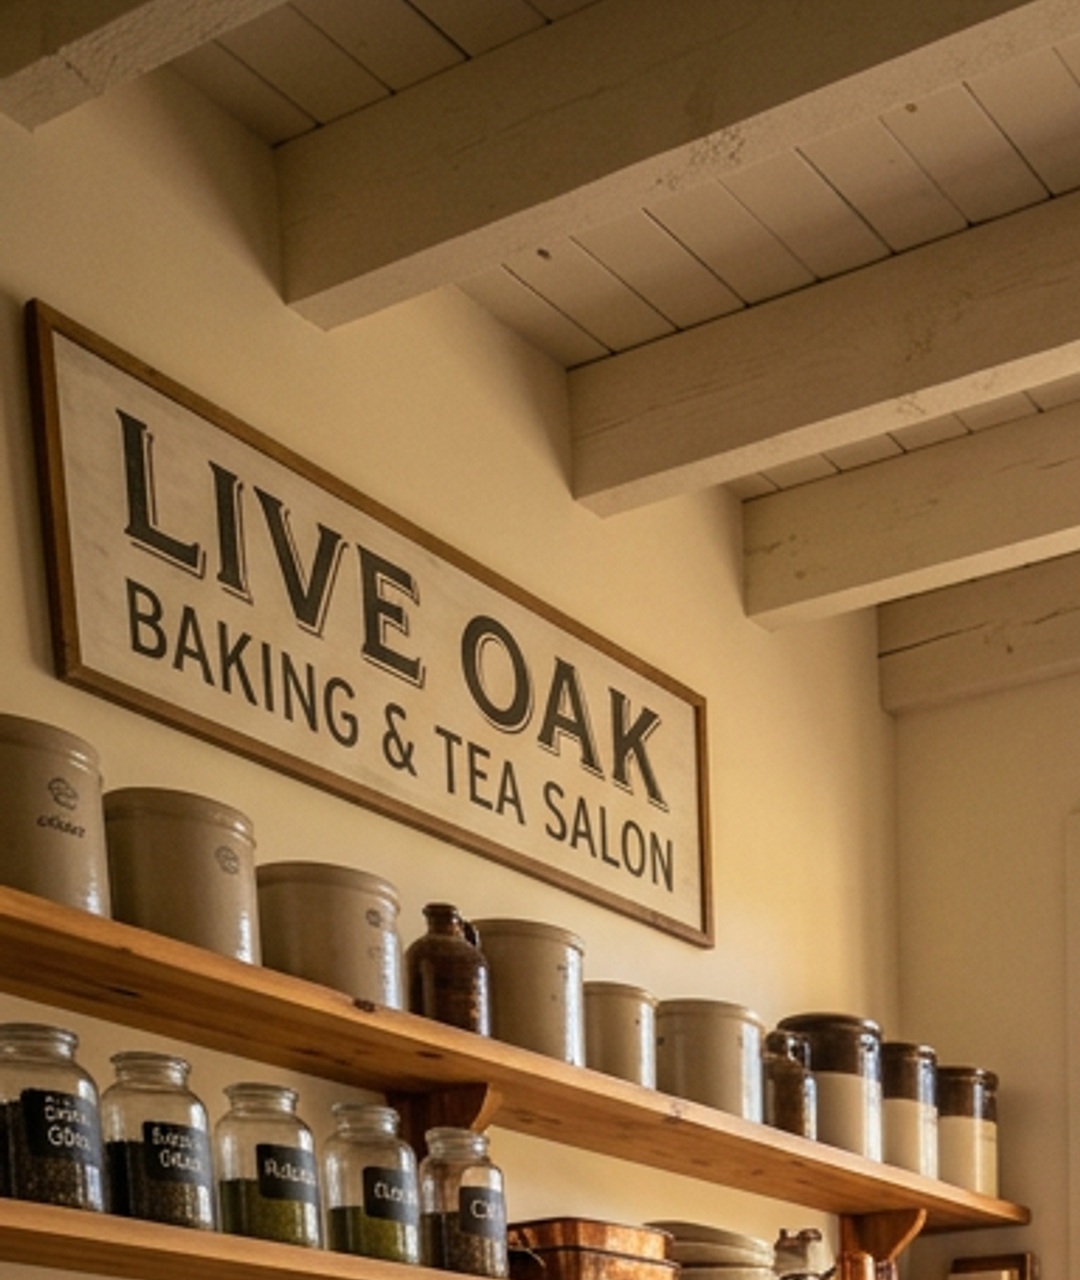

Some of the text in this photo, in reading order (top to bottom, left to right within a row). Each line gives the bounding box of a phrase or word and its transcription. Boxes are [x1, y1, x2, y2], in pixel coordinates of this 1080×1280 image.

[116, 407, 670, 814] LIVE OAK
[125, 576, 674, 894] BAKING & TEA SALON
